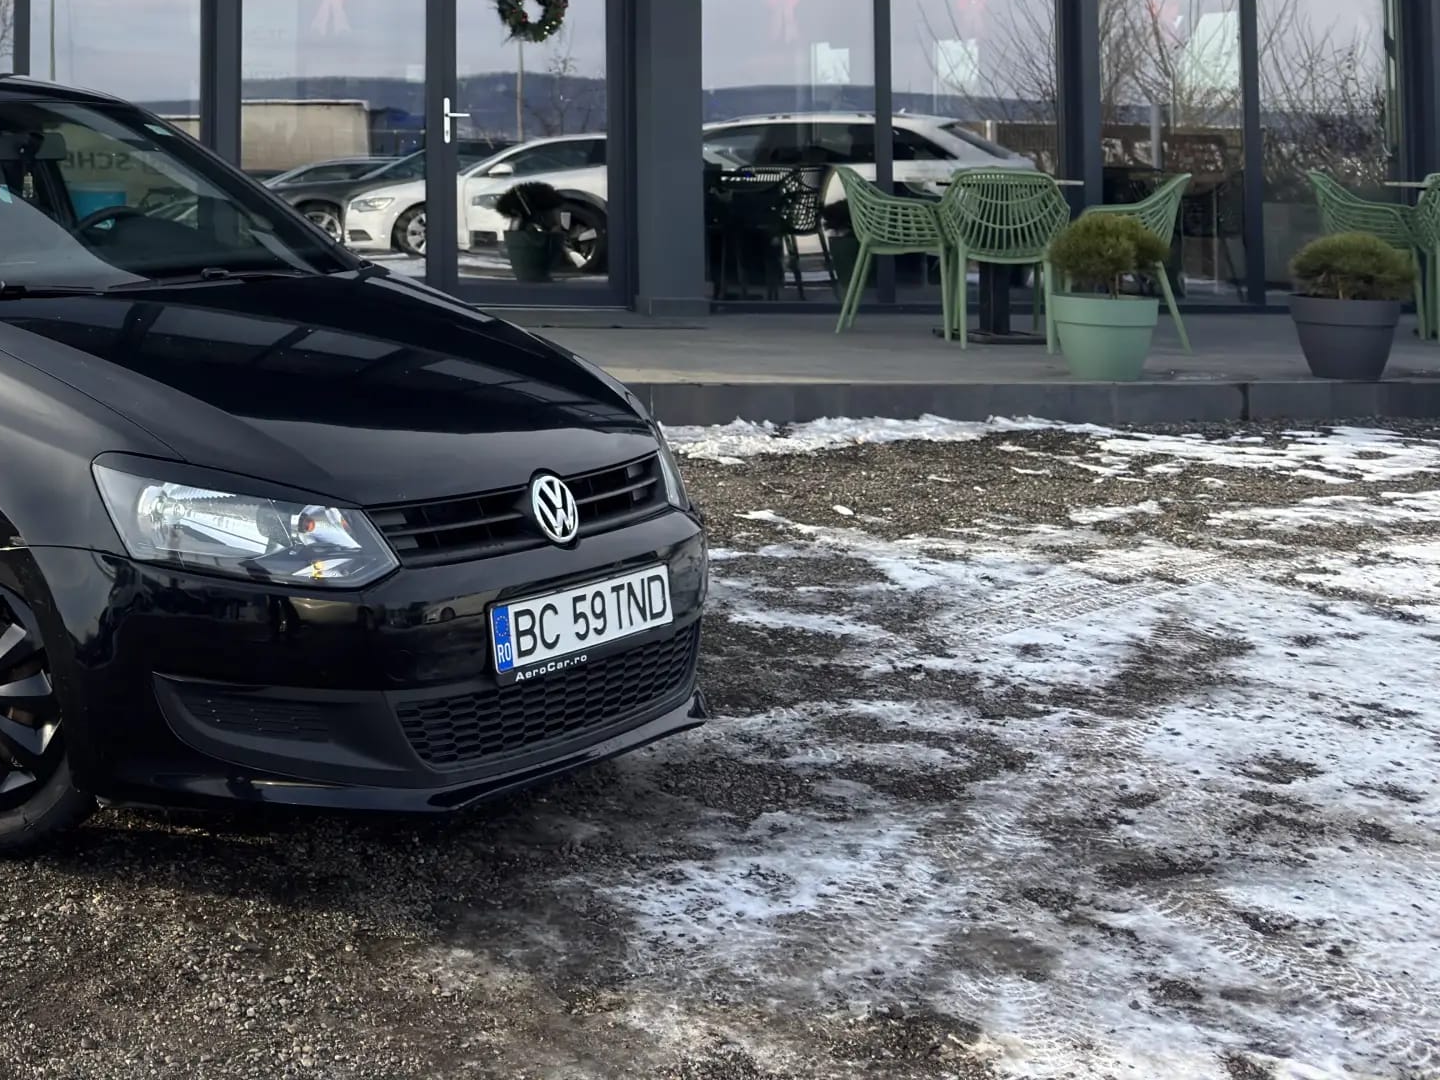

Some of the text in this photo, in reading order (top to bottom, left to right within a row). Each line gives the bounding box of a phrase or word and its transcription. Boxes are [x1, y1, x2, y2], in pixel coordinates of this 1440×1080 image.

[497, 574, 667, 663] RO BC 59 TND
[515, 654, 588, 682] AeroCar.ro
